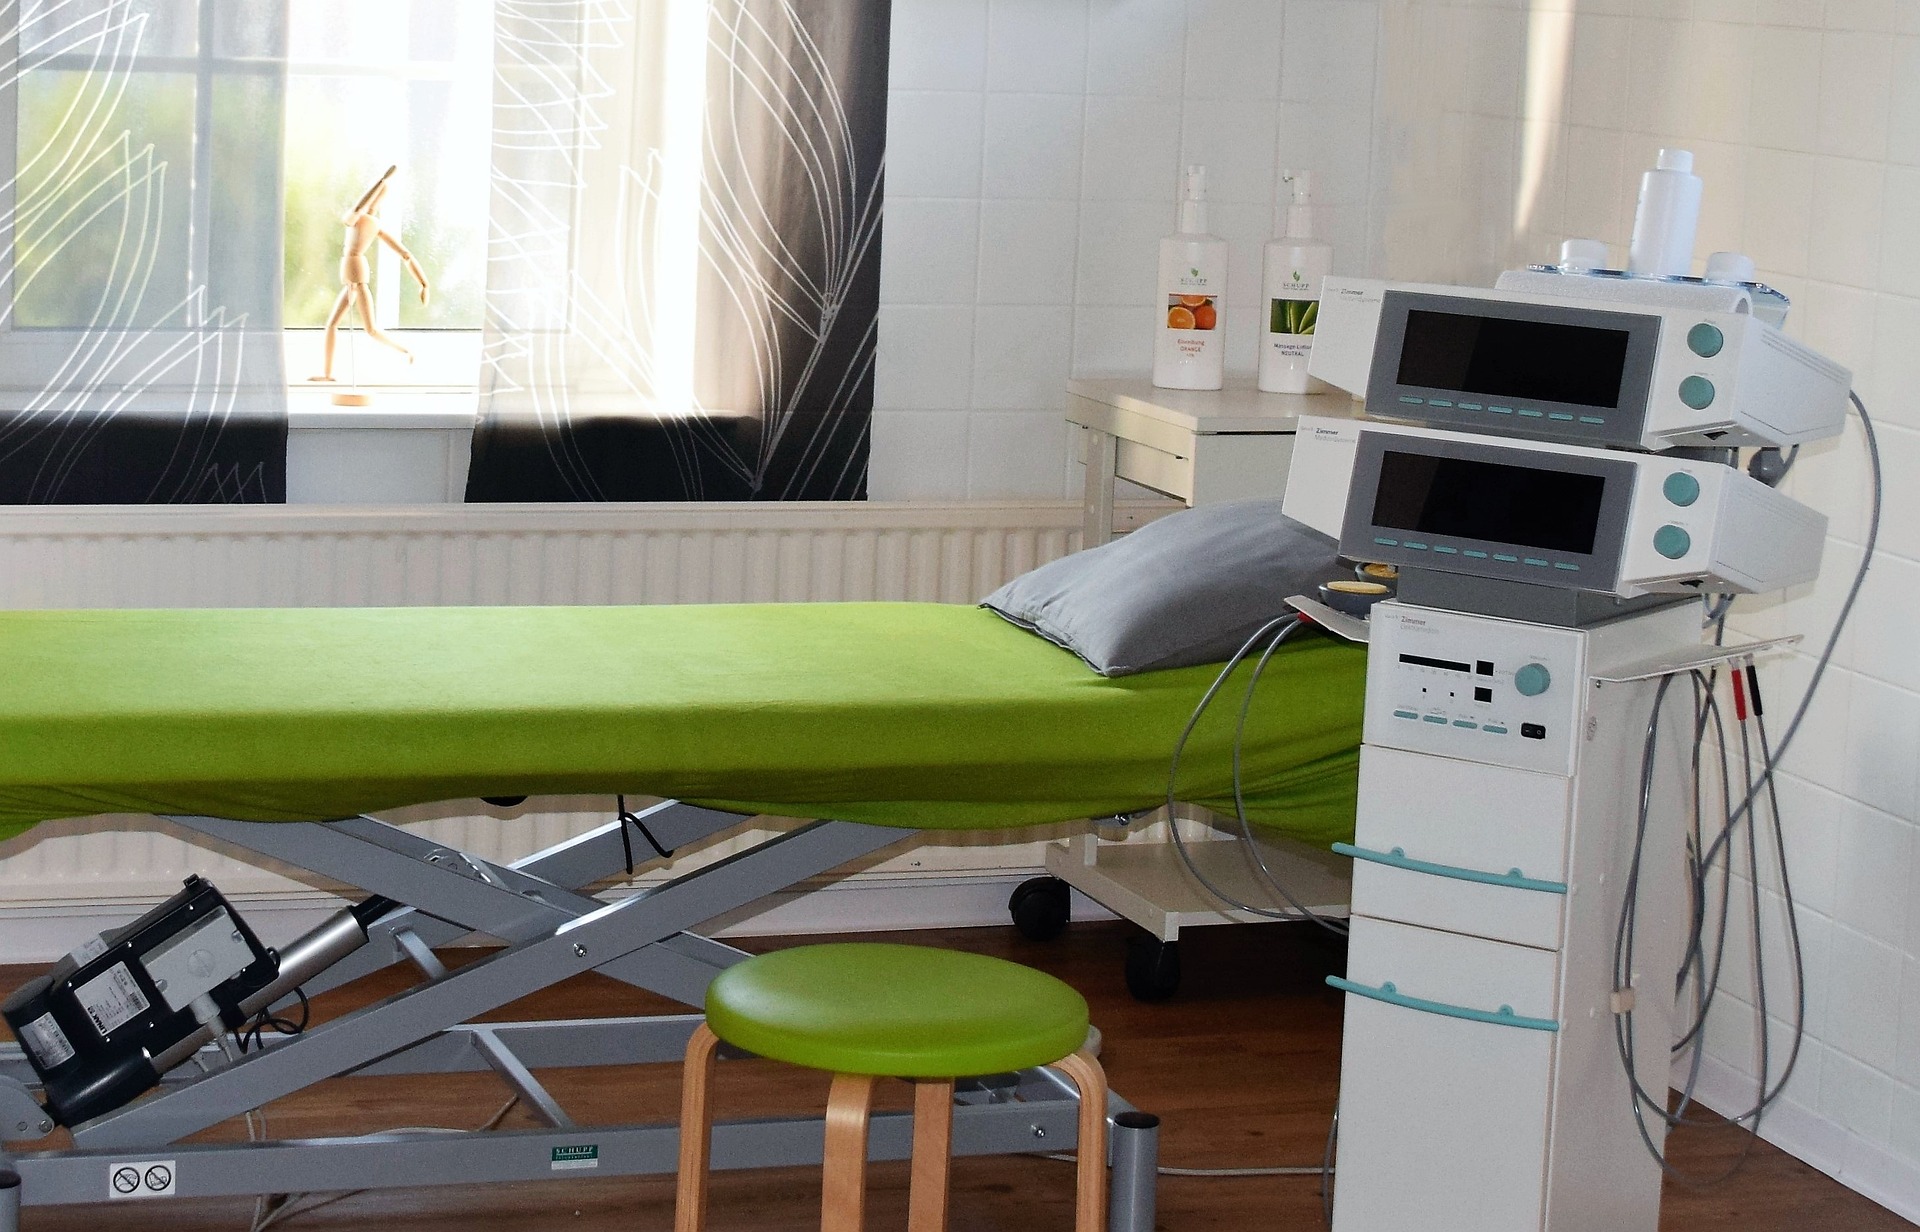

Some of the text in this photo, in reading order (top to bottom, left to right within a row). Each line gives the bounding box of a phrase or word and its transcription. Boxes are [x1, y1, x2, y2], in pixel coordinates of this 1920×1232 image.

[1340, 288, 1364, 296] Zimmer
[1315, 427, 1339, 436] Zimmer
[1401, 615, 1426, 626] Zimmer
[556, 1146, 593, 1154] SCHUPP
